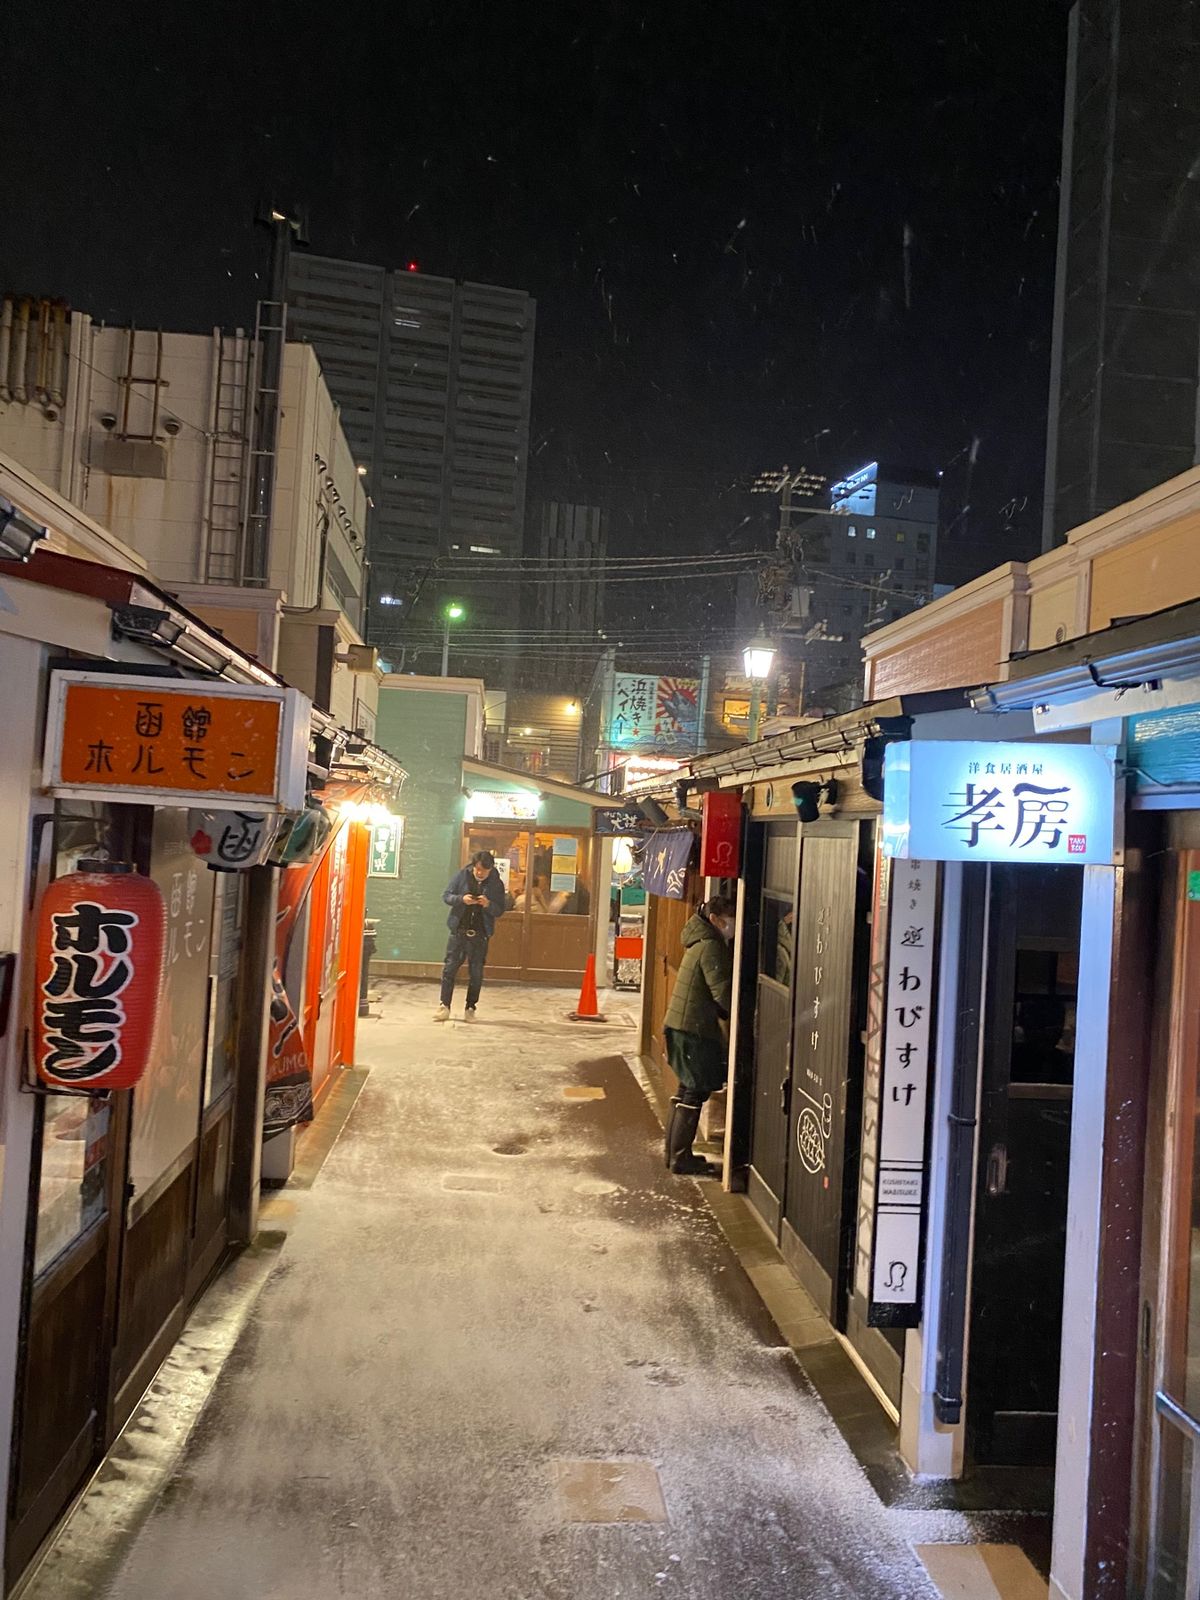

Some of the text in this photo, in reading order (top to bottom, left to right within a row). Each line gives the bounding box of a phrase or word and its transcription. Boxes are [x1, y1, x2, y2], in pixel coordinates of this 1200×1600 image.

[135, 702, 212, 742] 函館
[84, 739, 255, 782] ホルモン
[968, 761, 1044, 775] 洋食居酒屋
[941, 782, 1071, 849] 孝房
[41, 900, 140, 1082] ホルモン
[892, 966, 926, 1106] わびすけ
